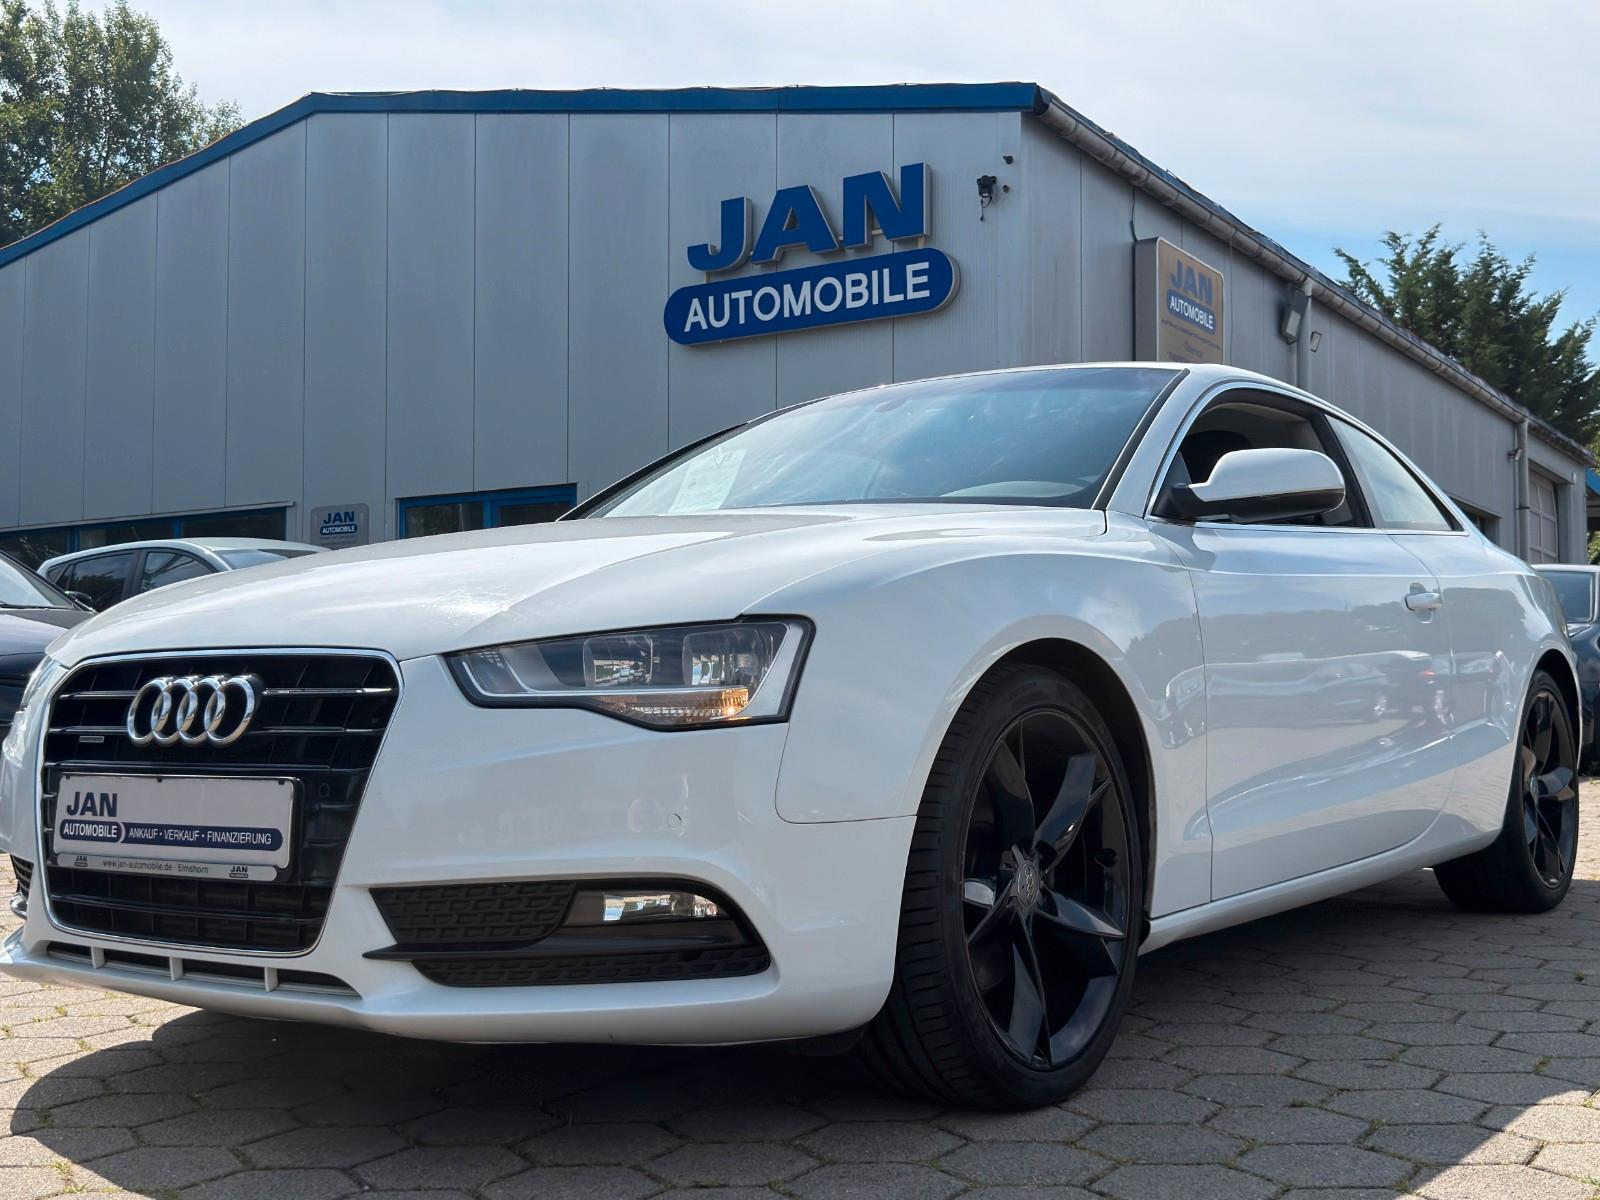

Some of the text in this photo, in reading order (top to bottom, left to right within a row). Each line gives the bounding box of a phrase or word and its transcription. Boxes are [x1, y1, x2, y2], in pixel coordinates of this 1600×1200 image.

[687, 162, 928, 272] JAN
[1169, 259, 1213, 305] JAN
[683, 261, 930, 332] AUTOMOBILE
[1169, 295, 1214, 330] AUTOMOBILE
[323, 511, 355, 524] JAN
[322, 525, 356, 534] AUTOMOBILE
[66, 791, 118, 818] JAN
[63, 823, 118, 838] AUTOMOBILE
[128, 829, 272, 845] ANKAUF VERKAUF FINANZIERUNG
[177, 863, 209, 874] Elmshorn
[230, 865, 249, 873] JAN
